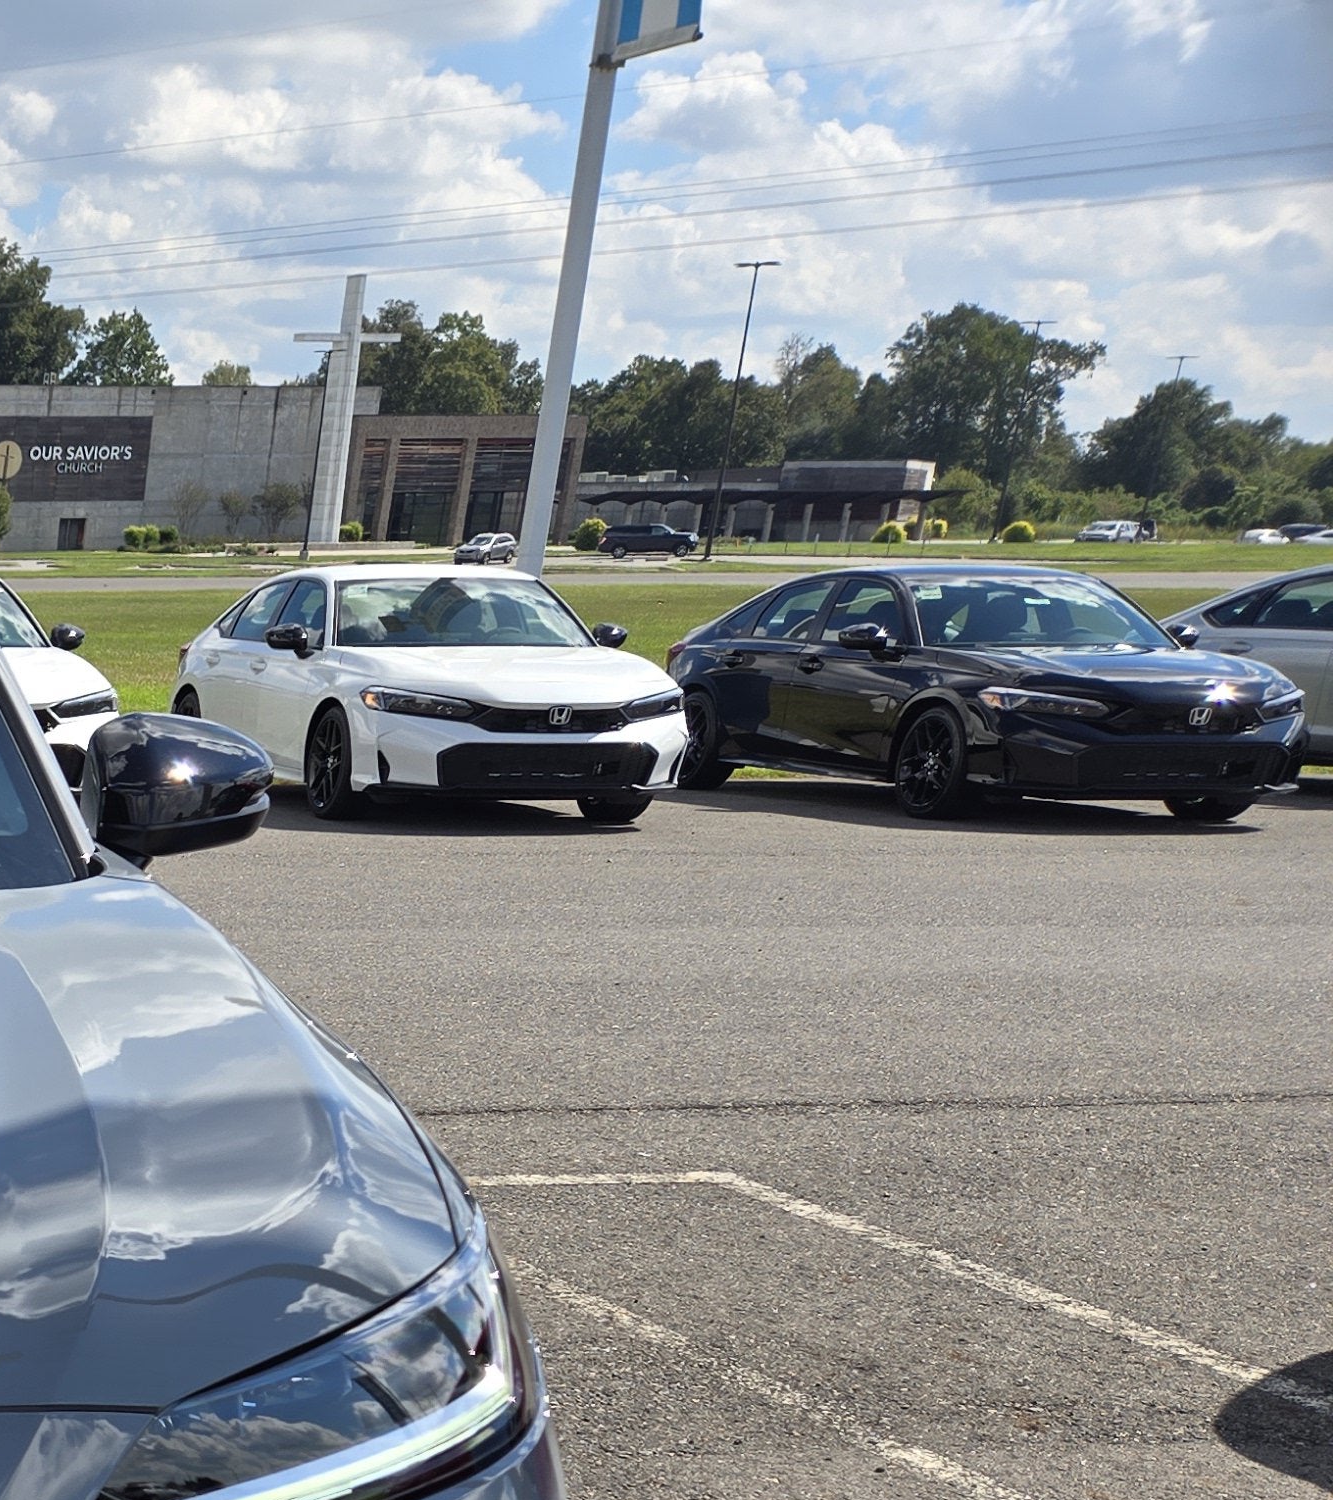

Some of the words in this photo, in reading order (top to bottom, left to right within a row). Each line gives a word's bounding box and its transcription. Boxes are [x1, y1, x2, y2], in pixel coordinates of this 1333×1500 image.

[29, 446, 63, 461] OUR
[66, 446, 132, 461] SAVIOR'S
[56, 462, 103, 474] CHURCH
